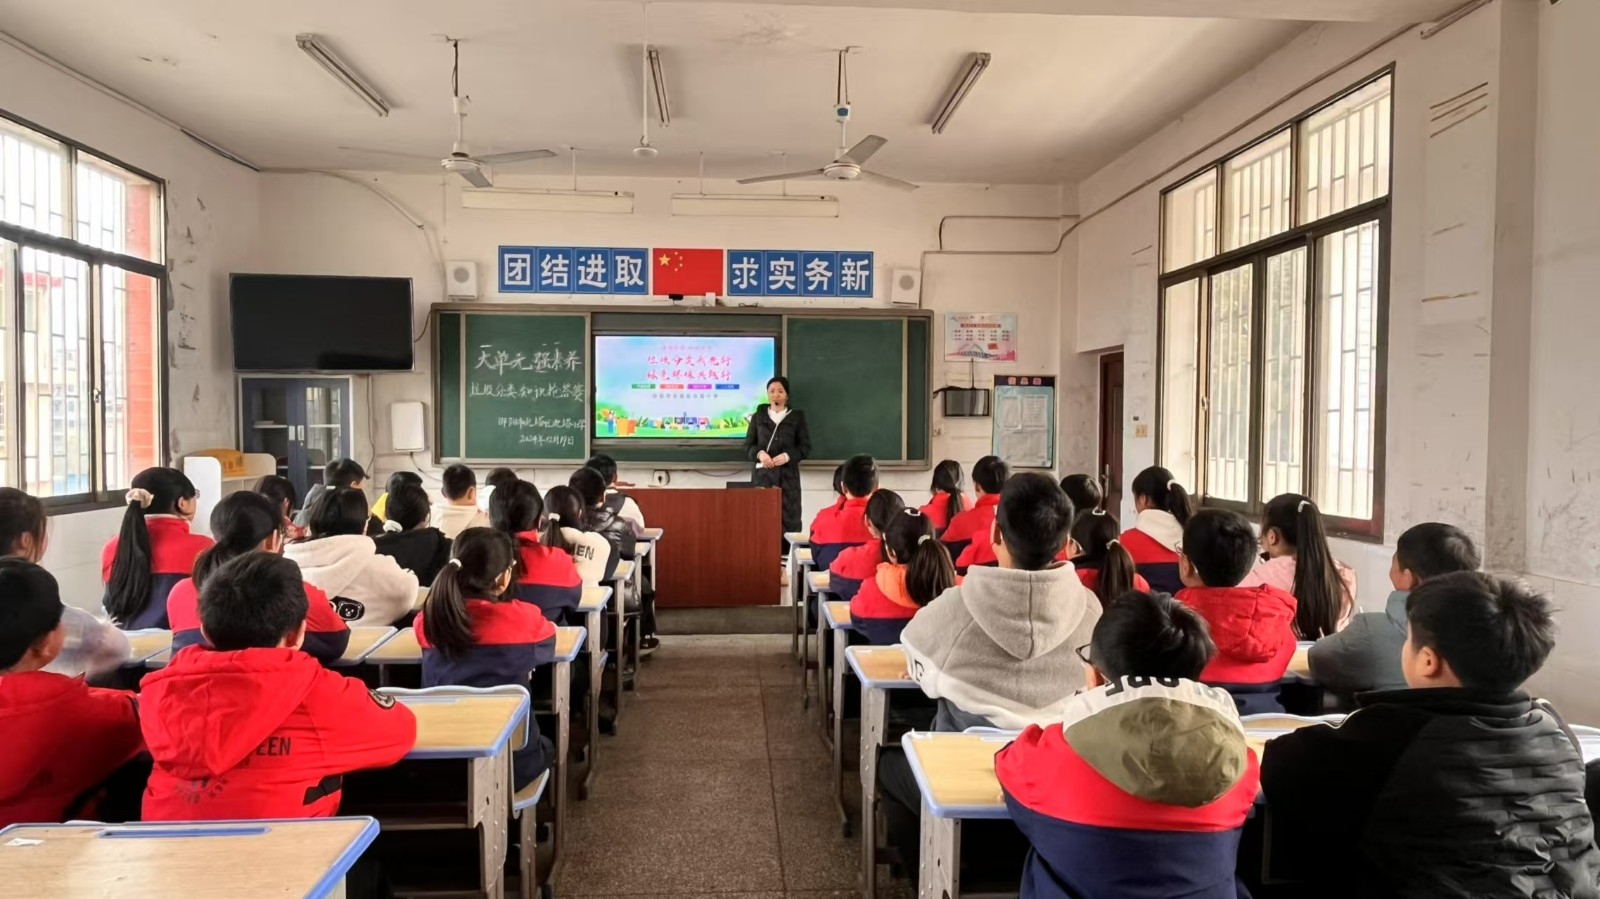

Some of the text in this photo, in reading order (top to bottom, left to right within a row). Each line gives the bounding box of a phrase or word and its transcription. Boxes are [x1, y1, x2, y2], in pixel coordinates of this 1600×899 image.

[504, 254, 644, 287] 团结进取
[731, 257, 869, 291] 求实务新
